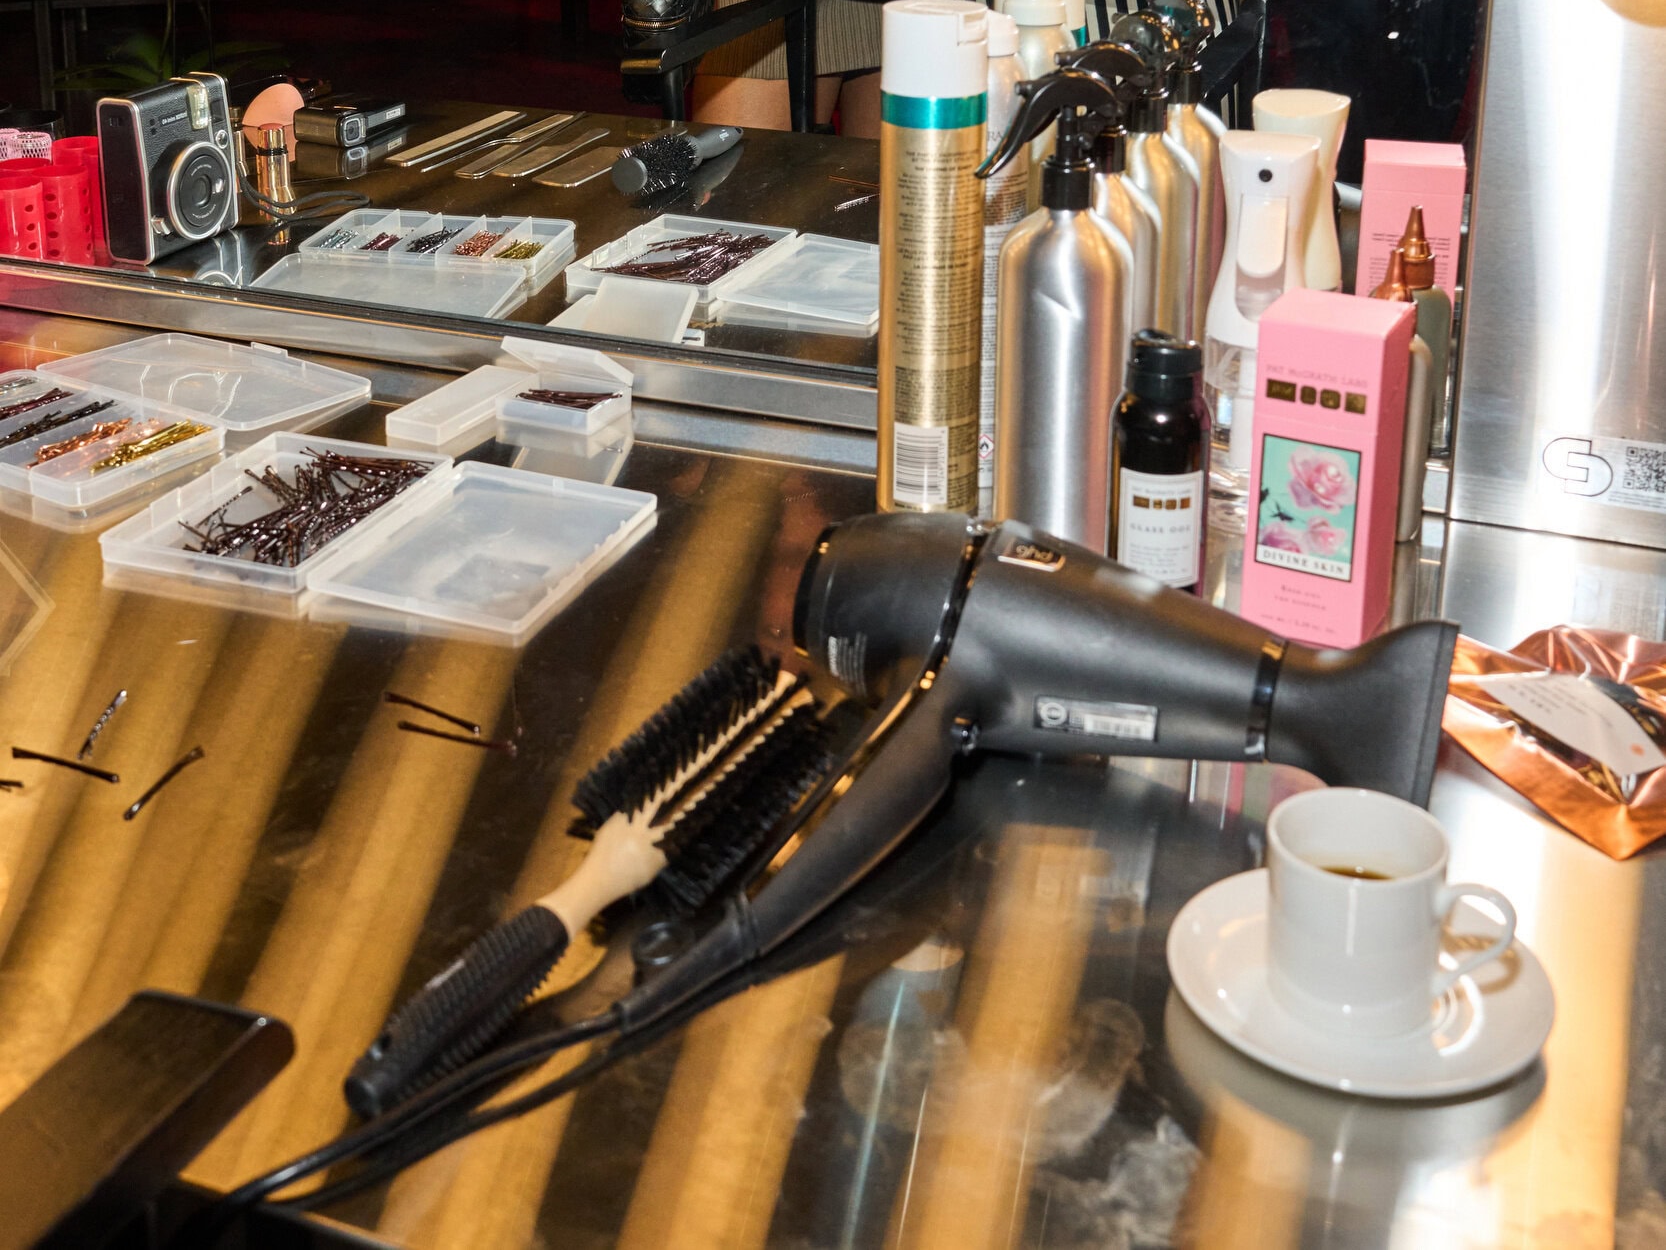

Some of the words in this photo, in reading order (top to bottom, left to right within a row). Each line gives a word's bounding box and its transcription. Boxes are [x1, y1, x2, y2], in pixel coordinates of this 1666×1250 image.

[1015, 543, 1054, 563] ghd
[1263, 549, 1309, 568] DIVINE
[1313, 560, 1345, 574] SKIN
